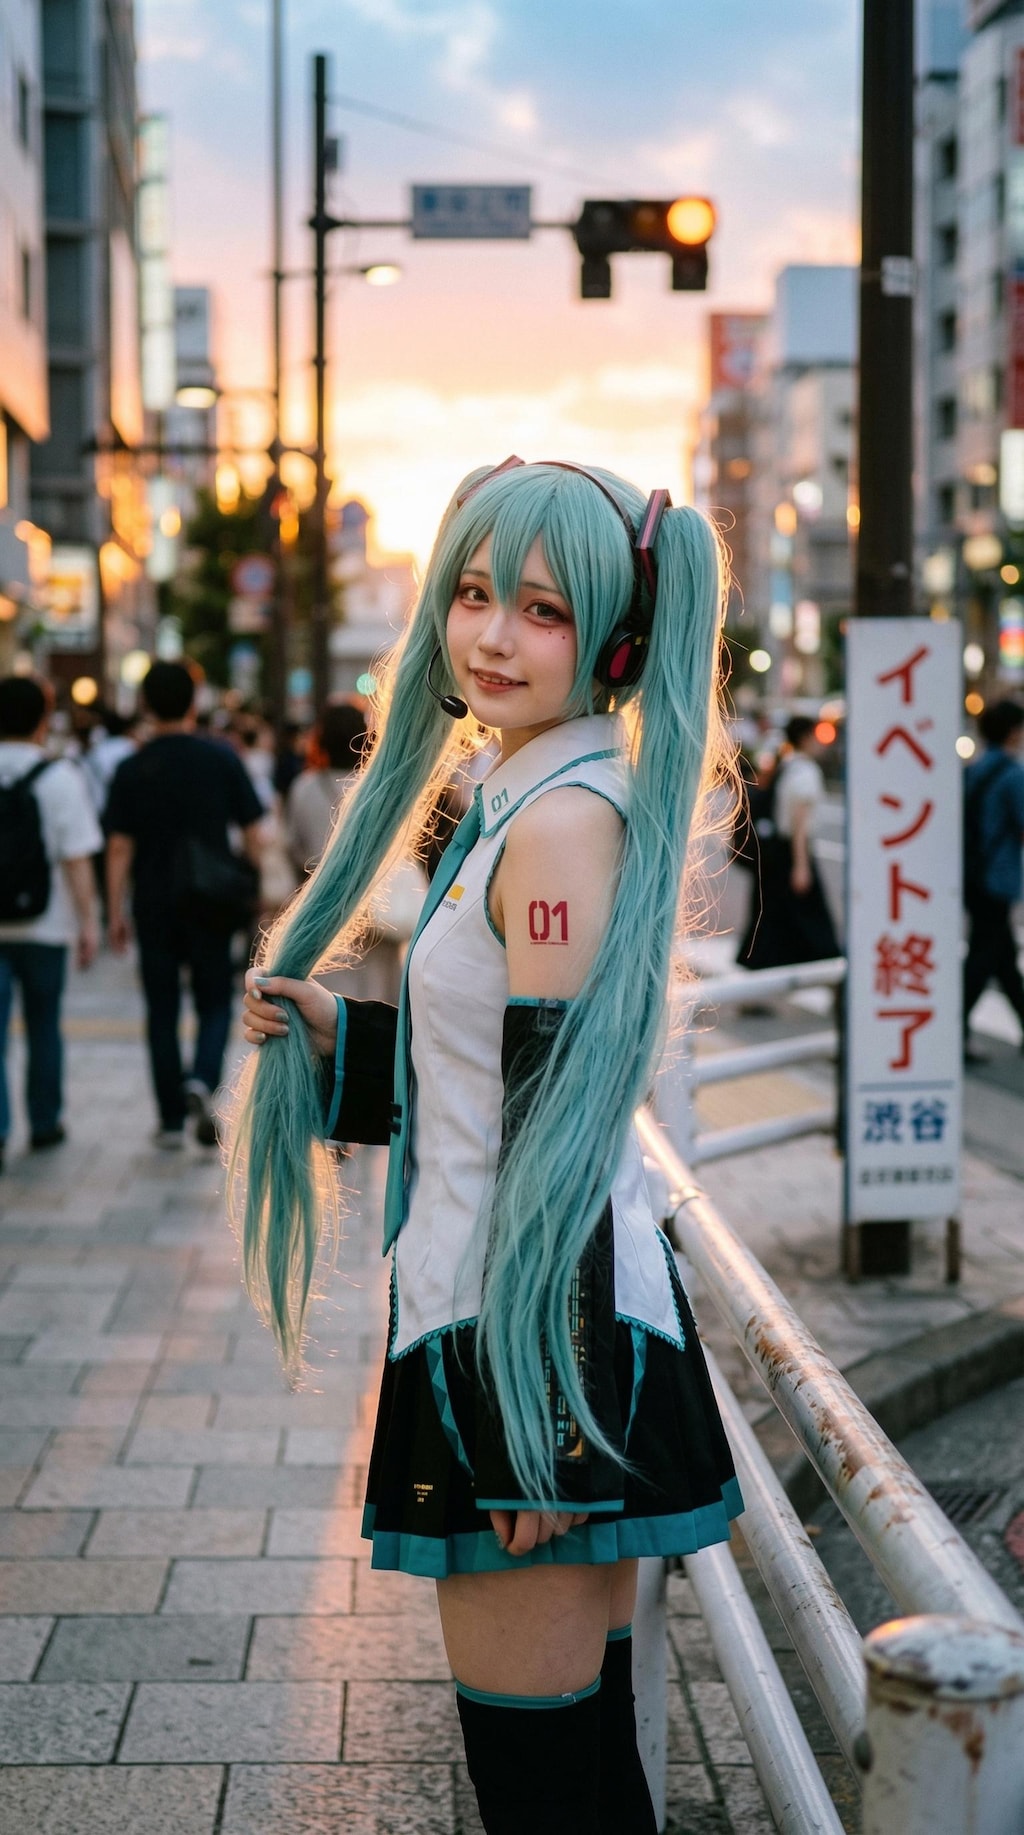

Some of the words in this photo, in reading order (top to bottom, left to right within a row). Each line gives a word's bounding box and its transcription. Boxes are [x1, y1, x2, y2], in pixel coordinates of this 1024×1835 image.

[491, 787, 509, 813] 01
[874, 643, 935, 1073] イベント終了
[528, 900, 568, 941] 01
[863, 1098, 947, 1143] 渋谷
